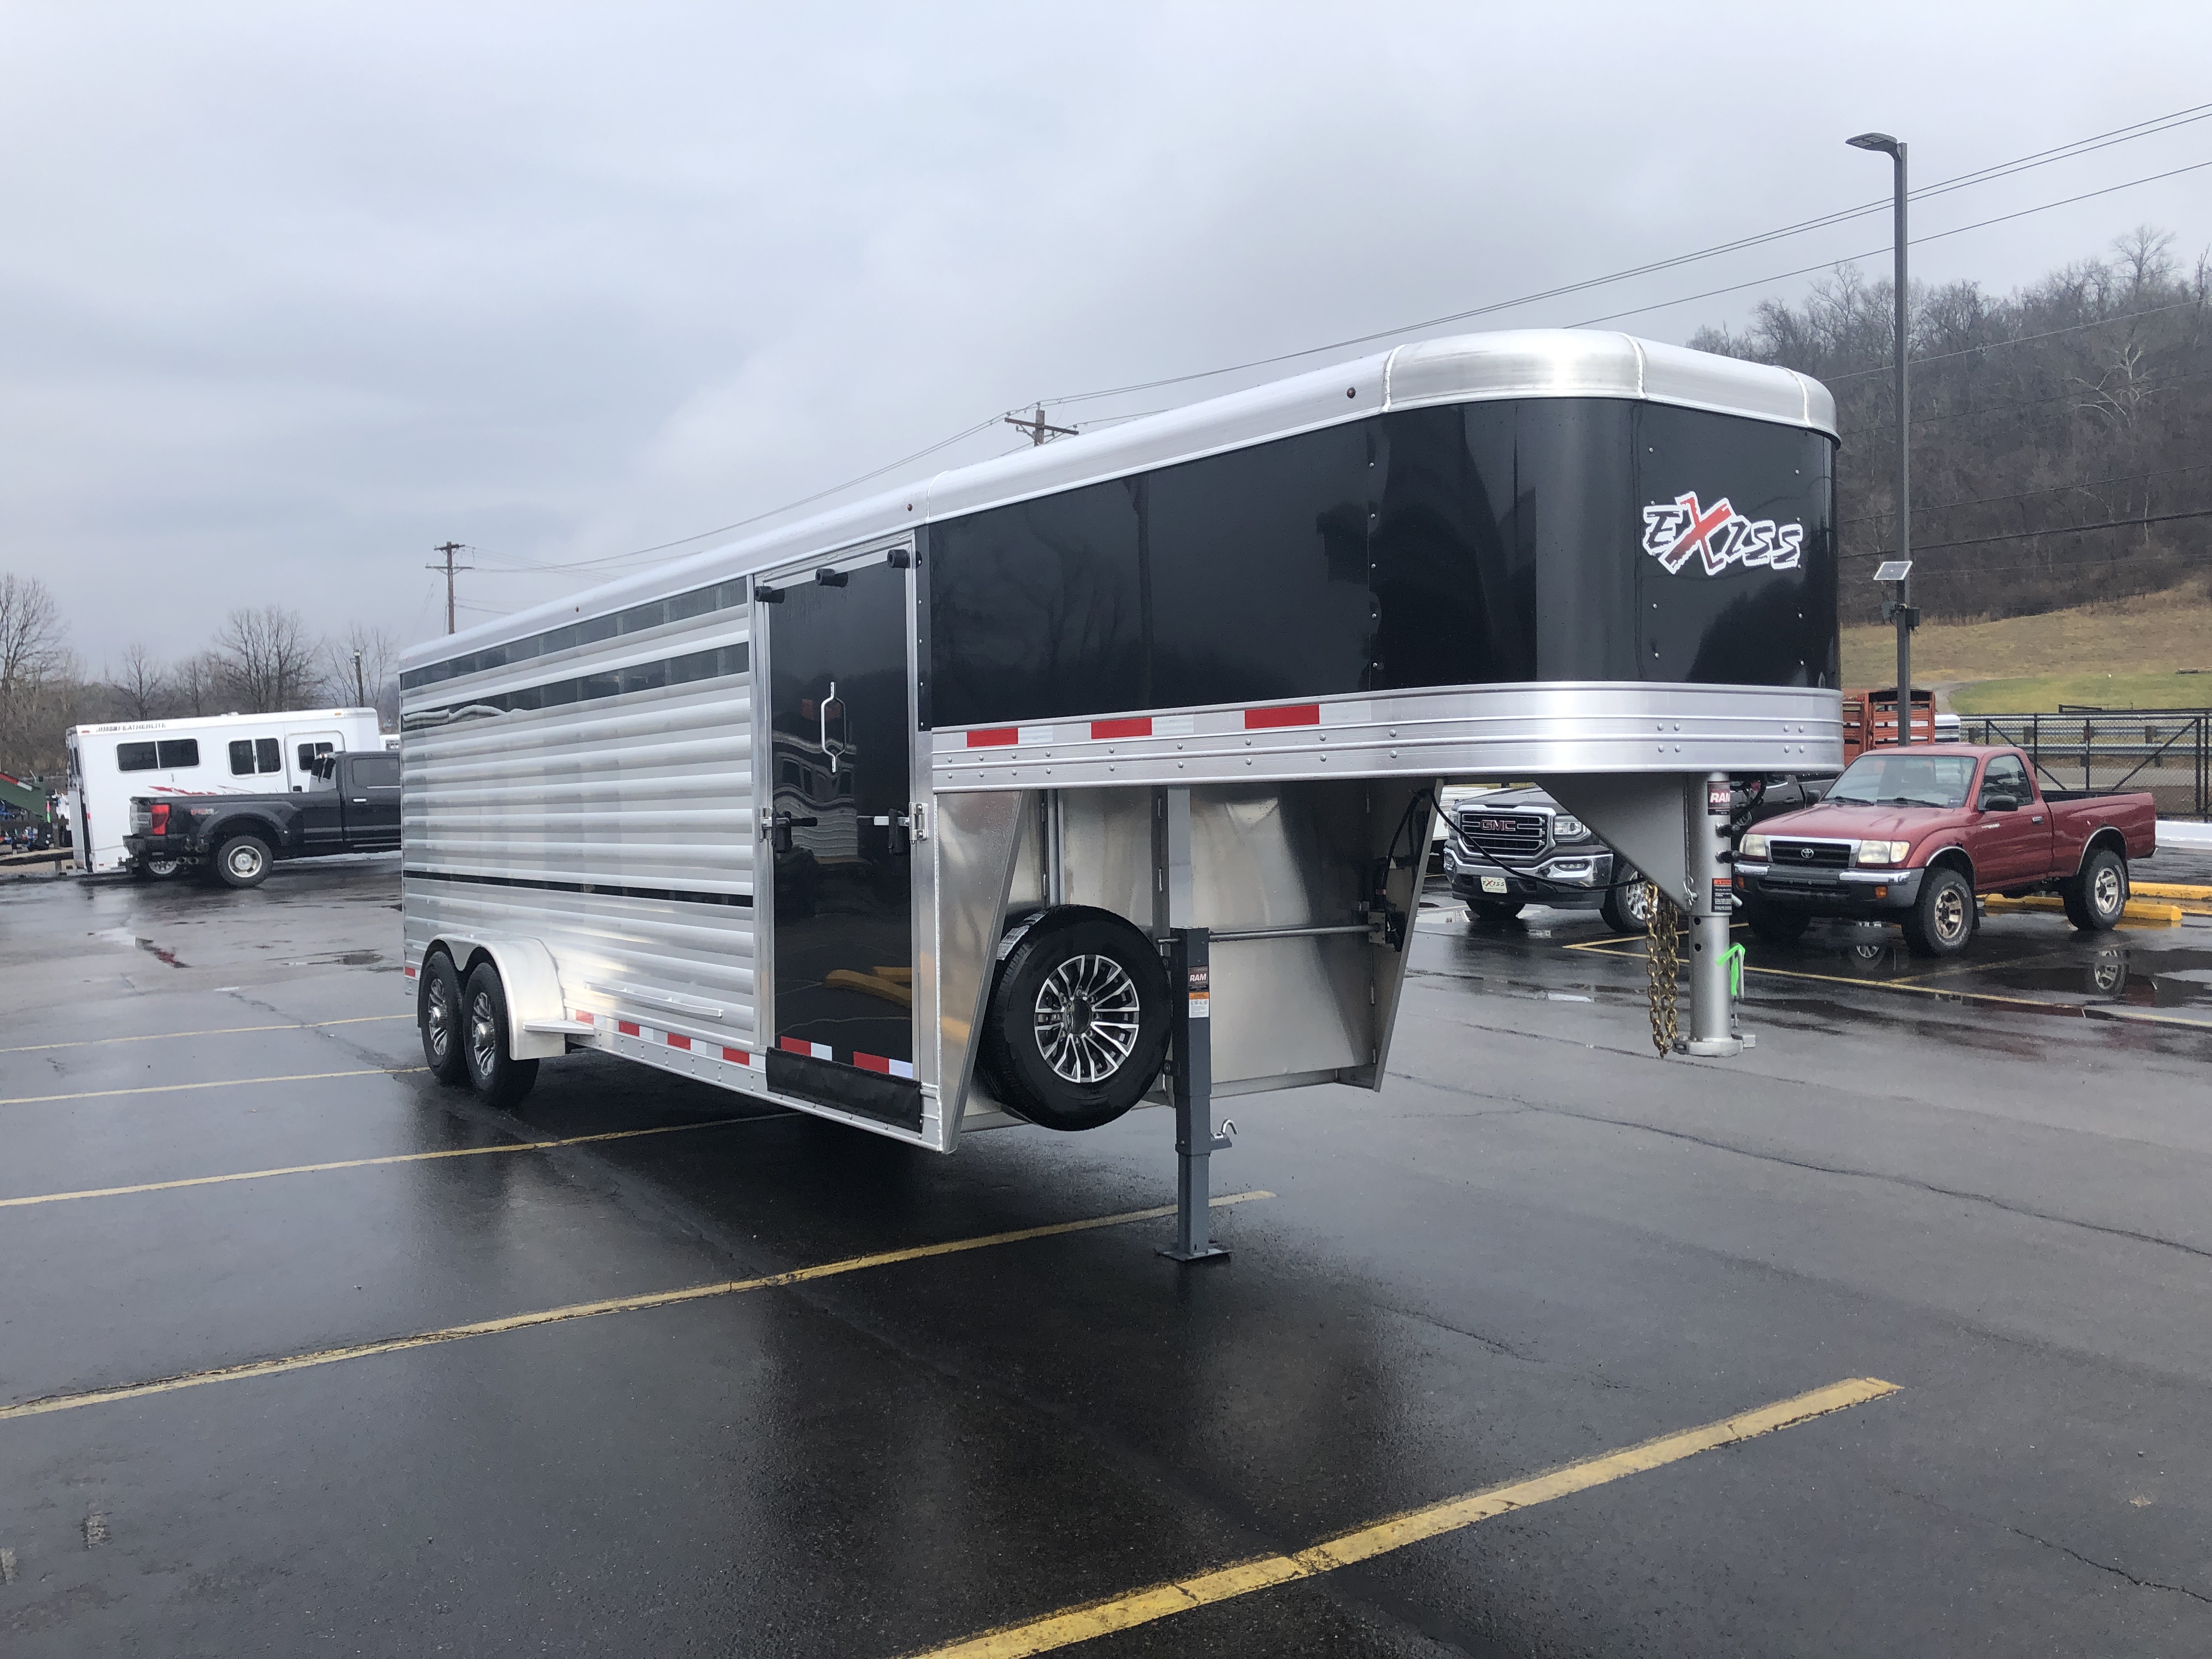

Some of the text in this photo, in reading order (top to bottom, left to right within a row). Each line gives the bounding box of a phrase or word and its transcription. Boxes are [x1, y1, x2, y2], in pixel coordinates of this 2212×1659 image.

[1643, 490, 1803, 575] EXISS
[1481, 820, 1516, 831] GMC
[1189, 973, 1207, 982] RAM
